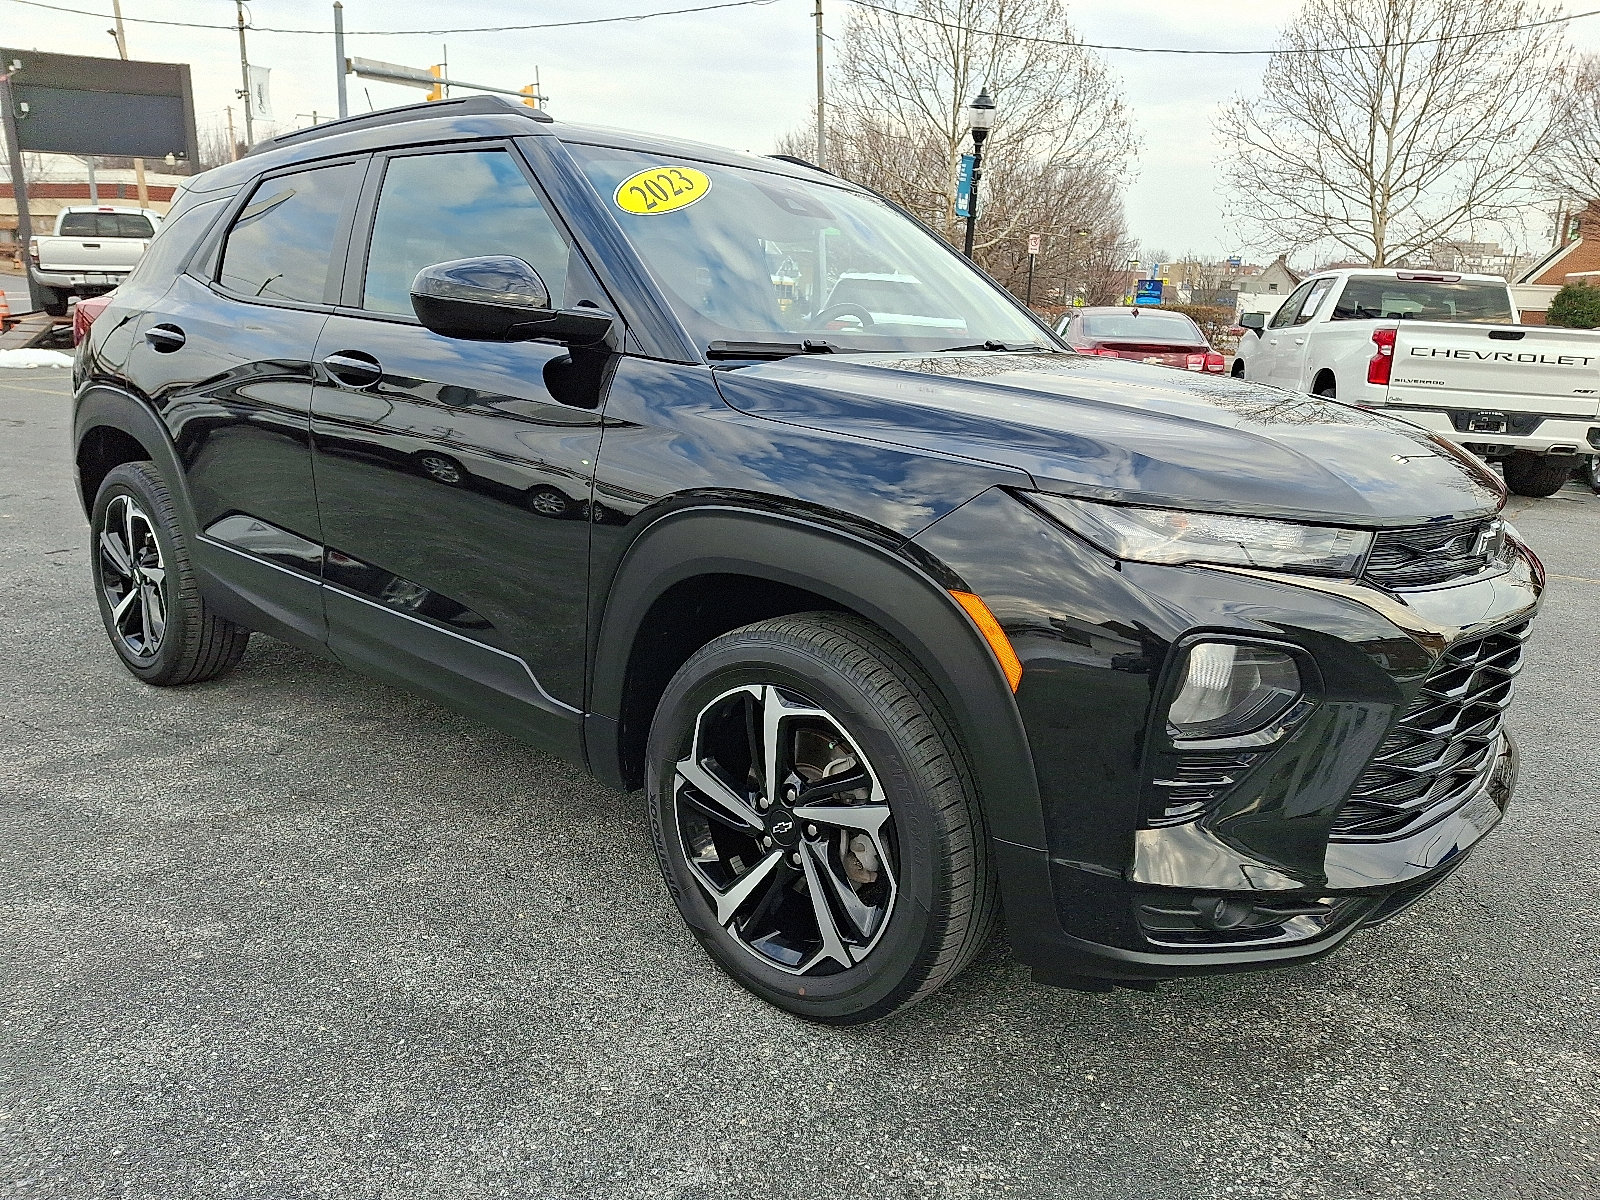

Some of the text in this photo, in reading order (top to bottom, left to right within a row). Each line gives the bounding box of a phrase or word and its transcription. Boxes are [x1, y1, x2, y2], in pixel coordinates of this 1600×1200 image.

[630, 169, 693, 210] 2023
[1410, 346, 1596, 367] CHEVROLET
[1394, 378, 1445, 386] SILVERADO
